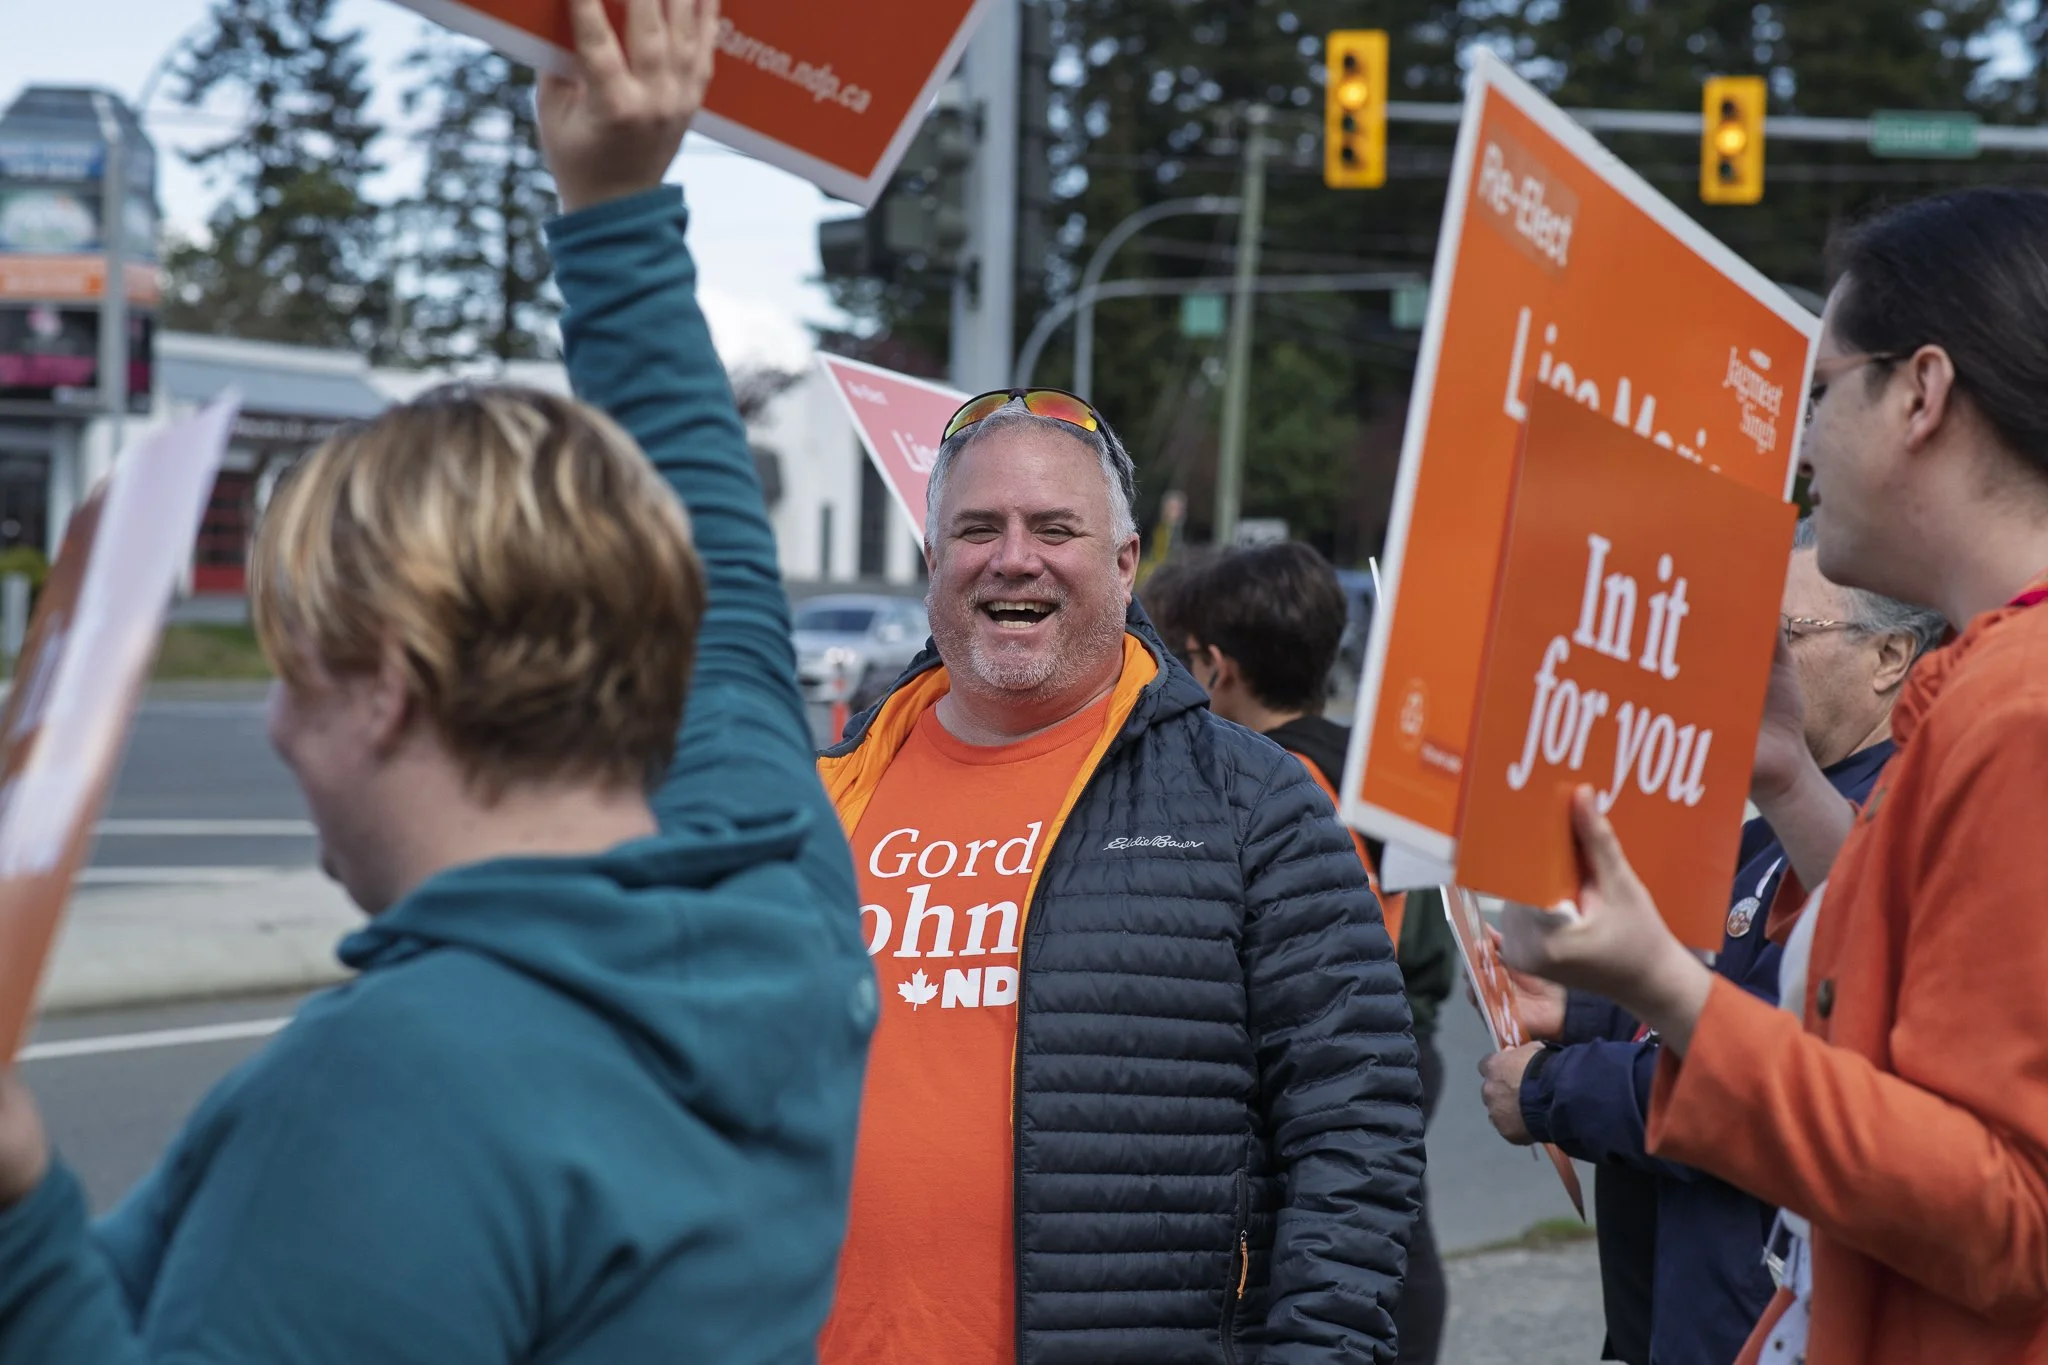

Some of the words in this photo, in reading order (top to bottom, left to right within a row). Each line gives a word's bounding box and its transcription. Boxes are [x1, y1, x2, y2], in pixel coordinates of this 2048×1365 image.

[1477, 140, 1572, 268] Re-Elect
[1740, 401, 1777, 455] Singh
[1572, 532, 1637, 662] In
[1638, 553, 1690, 681] it
[1506, 634, 1609, 790] for
[1595, 700, 1713, 815] you
[869, 820, 1043, 878] Gord
